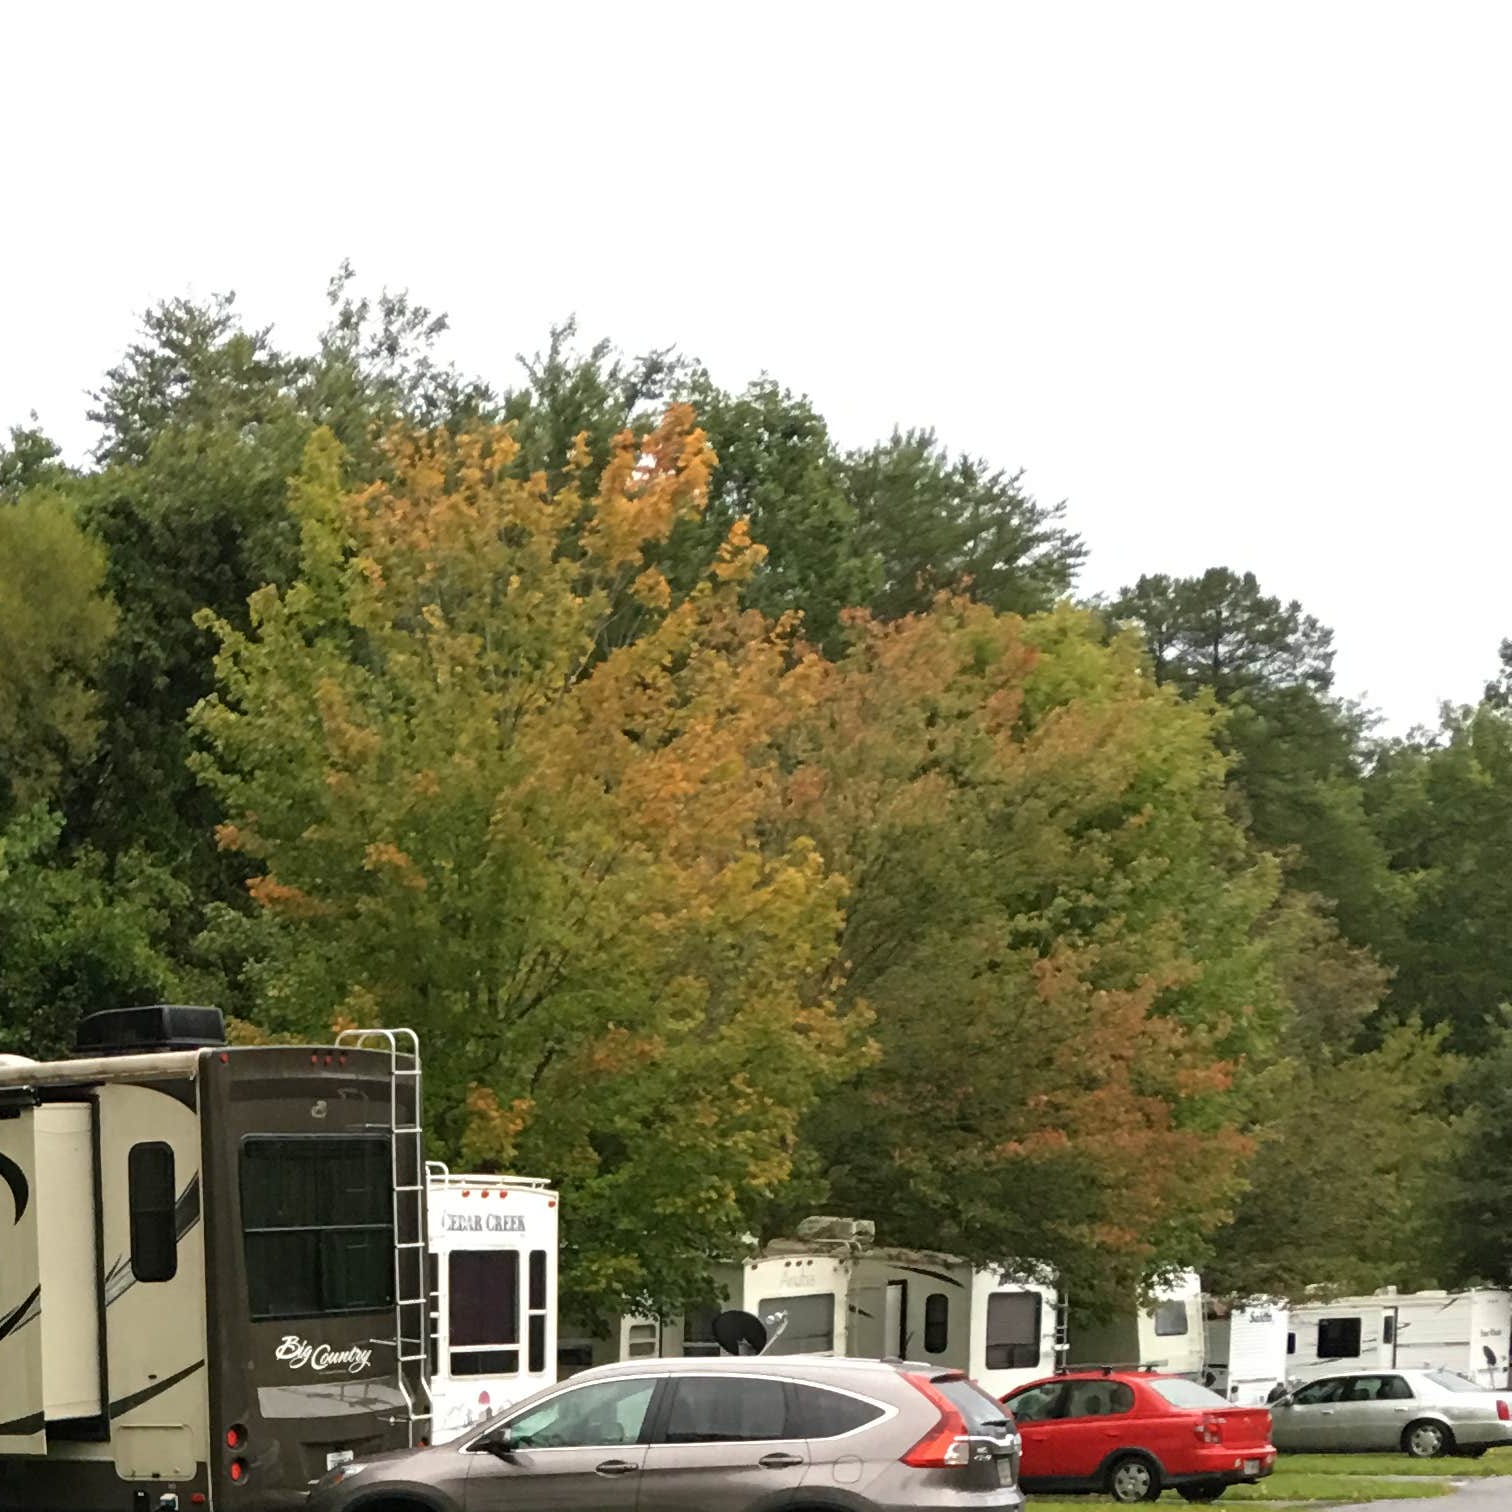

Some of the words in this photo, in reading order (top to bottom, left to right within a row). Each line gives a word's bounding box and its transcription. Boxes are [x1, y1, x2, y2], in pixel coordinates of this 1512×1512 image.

[441, 1210, 483, 1232] CEDAR
[486, 1212, 526, 1232] CREEK
[275, 1335, 313, 1369] Big
[310, 1343, 372, 1374] Country
